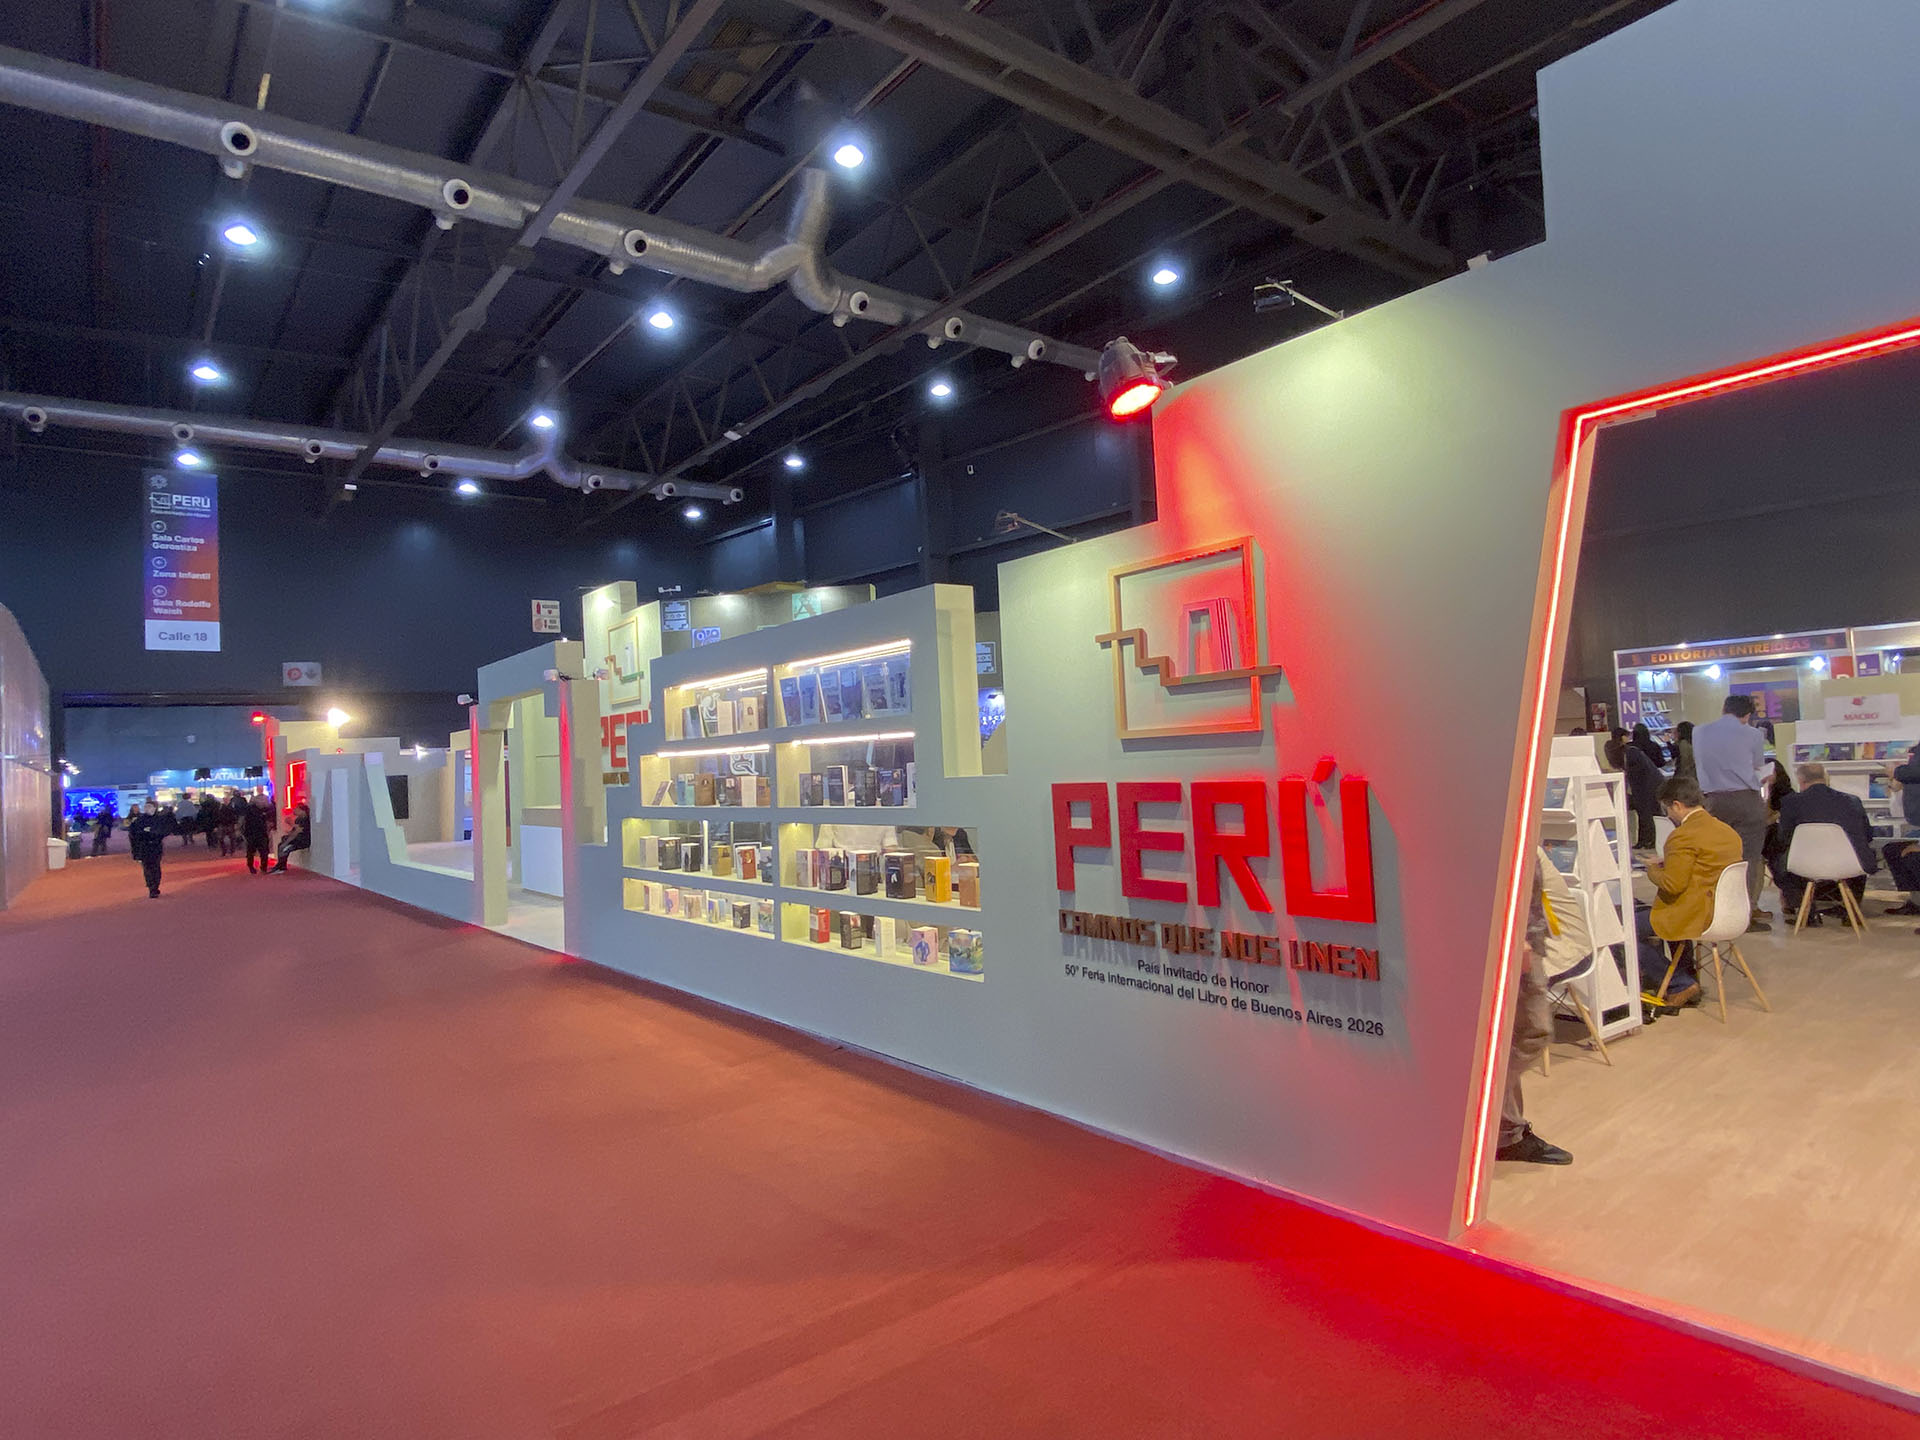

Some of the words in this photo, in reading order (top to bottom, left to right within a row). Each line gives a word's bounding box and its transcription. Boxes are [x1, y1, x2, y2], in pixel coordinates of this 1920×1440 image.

[172, 495, 211, 508] PERÚ
[158, 632, 191, 641] Calle
[194, 632, 208, 641] 18
[1651, 648, 1725, 663] EDITORIAL
[1844, 711, 1880, 720] MACRO
[1051, 757, 1376, 923] PERÚ
[1059, 909, 1156, 947] CAMINOS
[1161, 923, 1214, 956] QUE
[1221, 930, 1280, 966] NOS
[1288, 938, 1380, 981] UNEN
[1137, 960, 1160, 975] País
[1163, 963, 1207, 983] Invitado
[1211, 973, 1227, 987] de
[1230, 976, 1270, 994] Honor
[1082, 967, 1105, 982] Feria
[1108, 974, 1174, 995] Internacional
[1177, 985, 1194, 999] del
[1198, 988, 1227, 1006] Libro
[1231, 996, 1247, 1010] de
[1251, 999, 1302, 1021] Buenos
[1306, 1009, 1342, 1029] Aires
[1347, 1017, 1384, 1036] 2026
